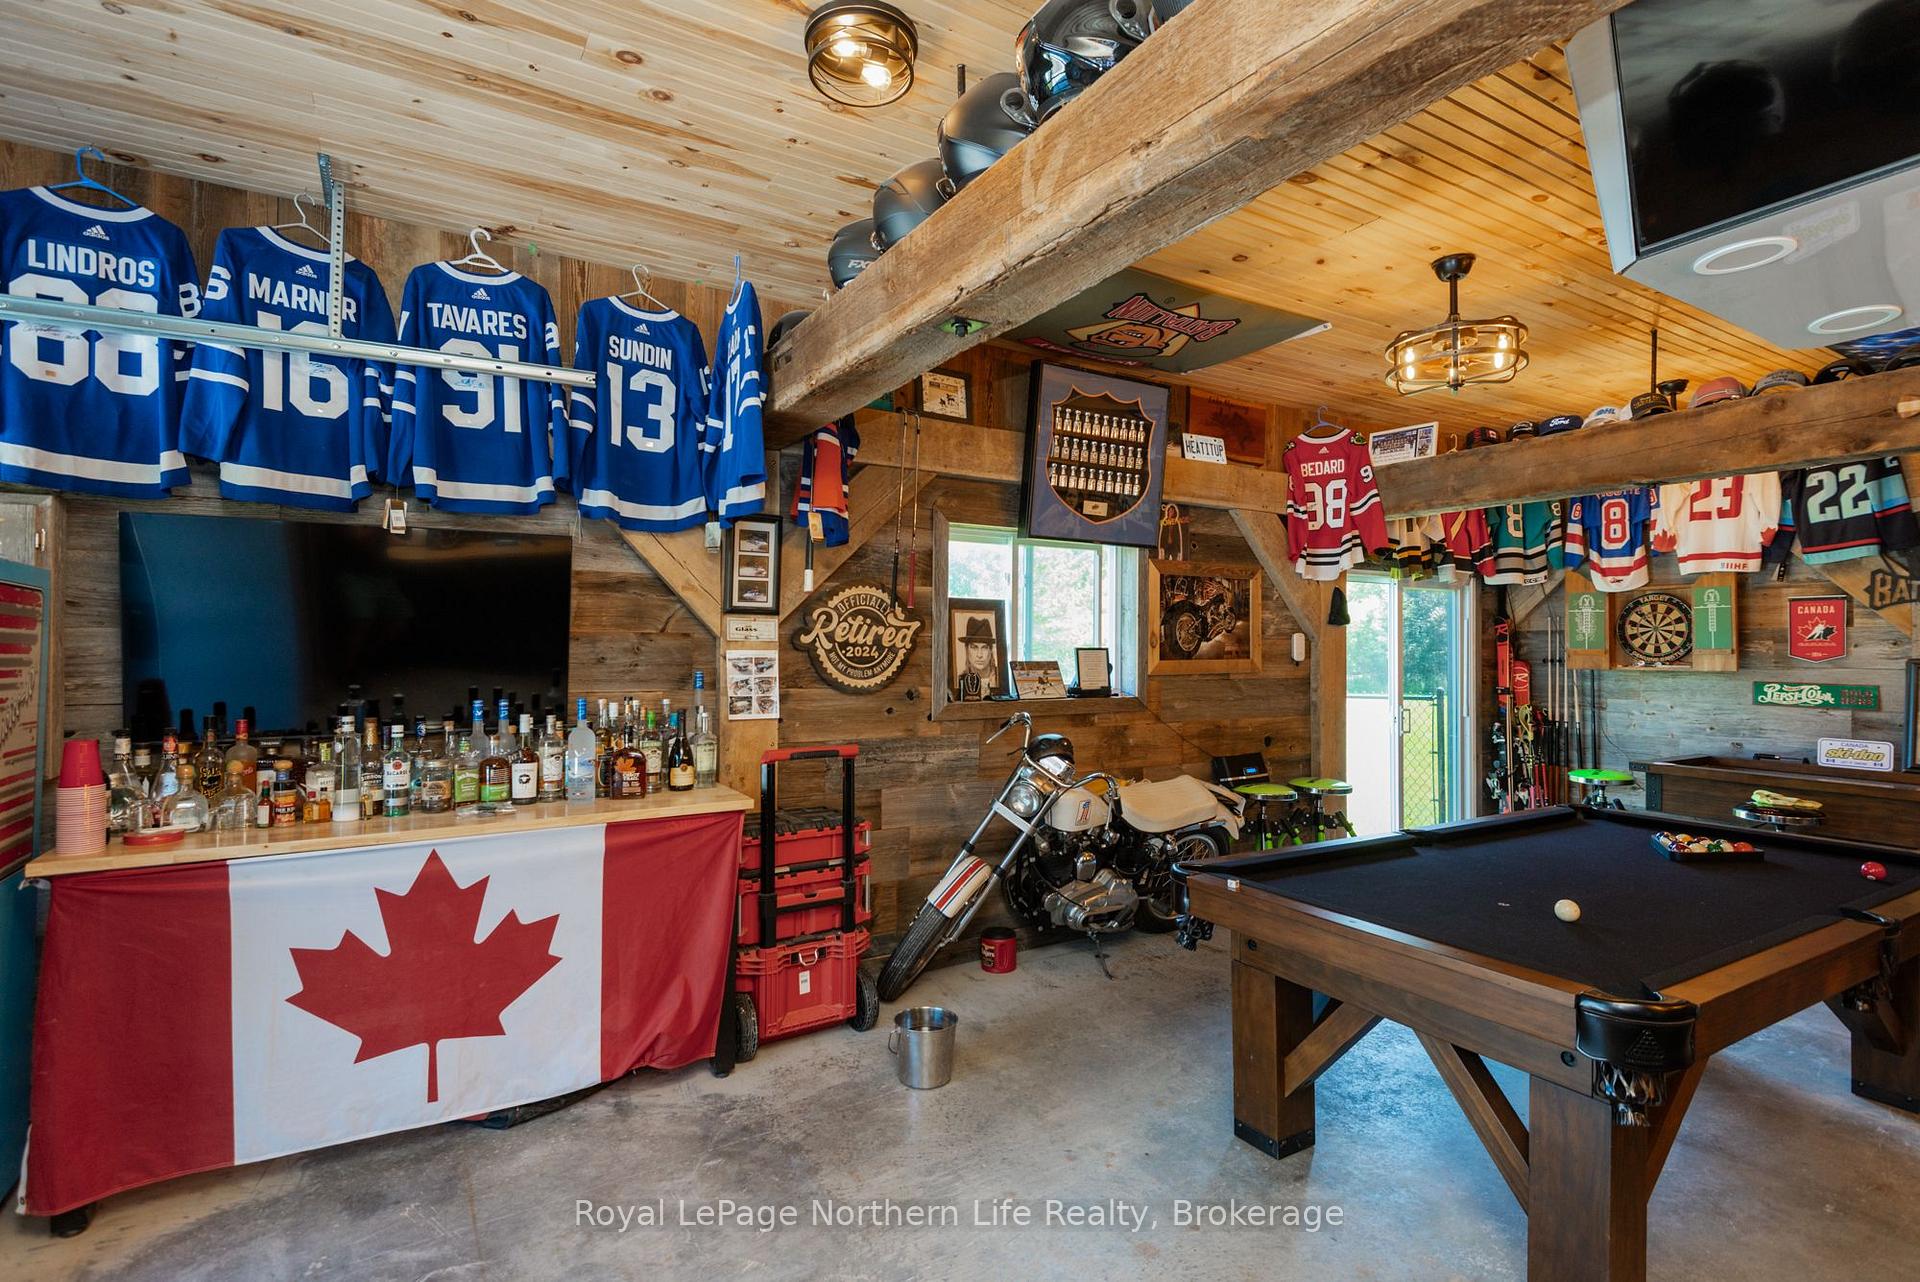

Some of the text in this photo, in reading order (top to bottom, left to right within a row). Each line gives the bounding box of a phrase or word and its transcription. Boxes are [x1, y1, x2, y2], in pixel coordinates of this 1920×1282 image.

[28, 239, 155, 288] LINDROS
[248, 273, 357, 323] MARNR
[1106, 296, 1237, 341] BATTALION
[427, 302, 528, 340] TAVARES
[257, 311, 349, 420] 16
[608, 335, 672, 370] SUNDIN
[440, 338, 522, 433] 91
[606, 361, 677, 453] 13
[1549, 417, 1570, 427] Ford
[1185, 440, 1224, 457] HEATITUP
[1300, 459, 1345, 477] BEDARD
[1690, 475, 1745, 522] 23
[1805, 464, 1873, 524] 22
[1602, 498, 1630, 550] 8
[837, 594, 891, 615] OFFICIALLY
[1797, 605, 1836, 615] CANADA
[800, 607, 921, 650] Retired
[829, 651, 840, 665] NOT
[845, 667, 873, 678] PROBLEM
[873, 651, 896, 675] ANYMORE
[845, 646, 879, 659] 2024
